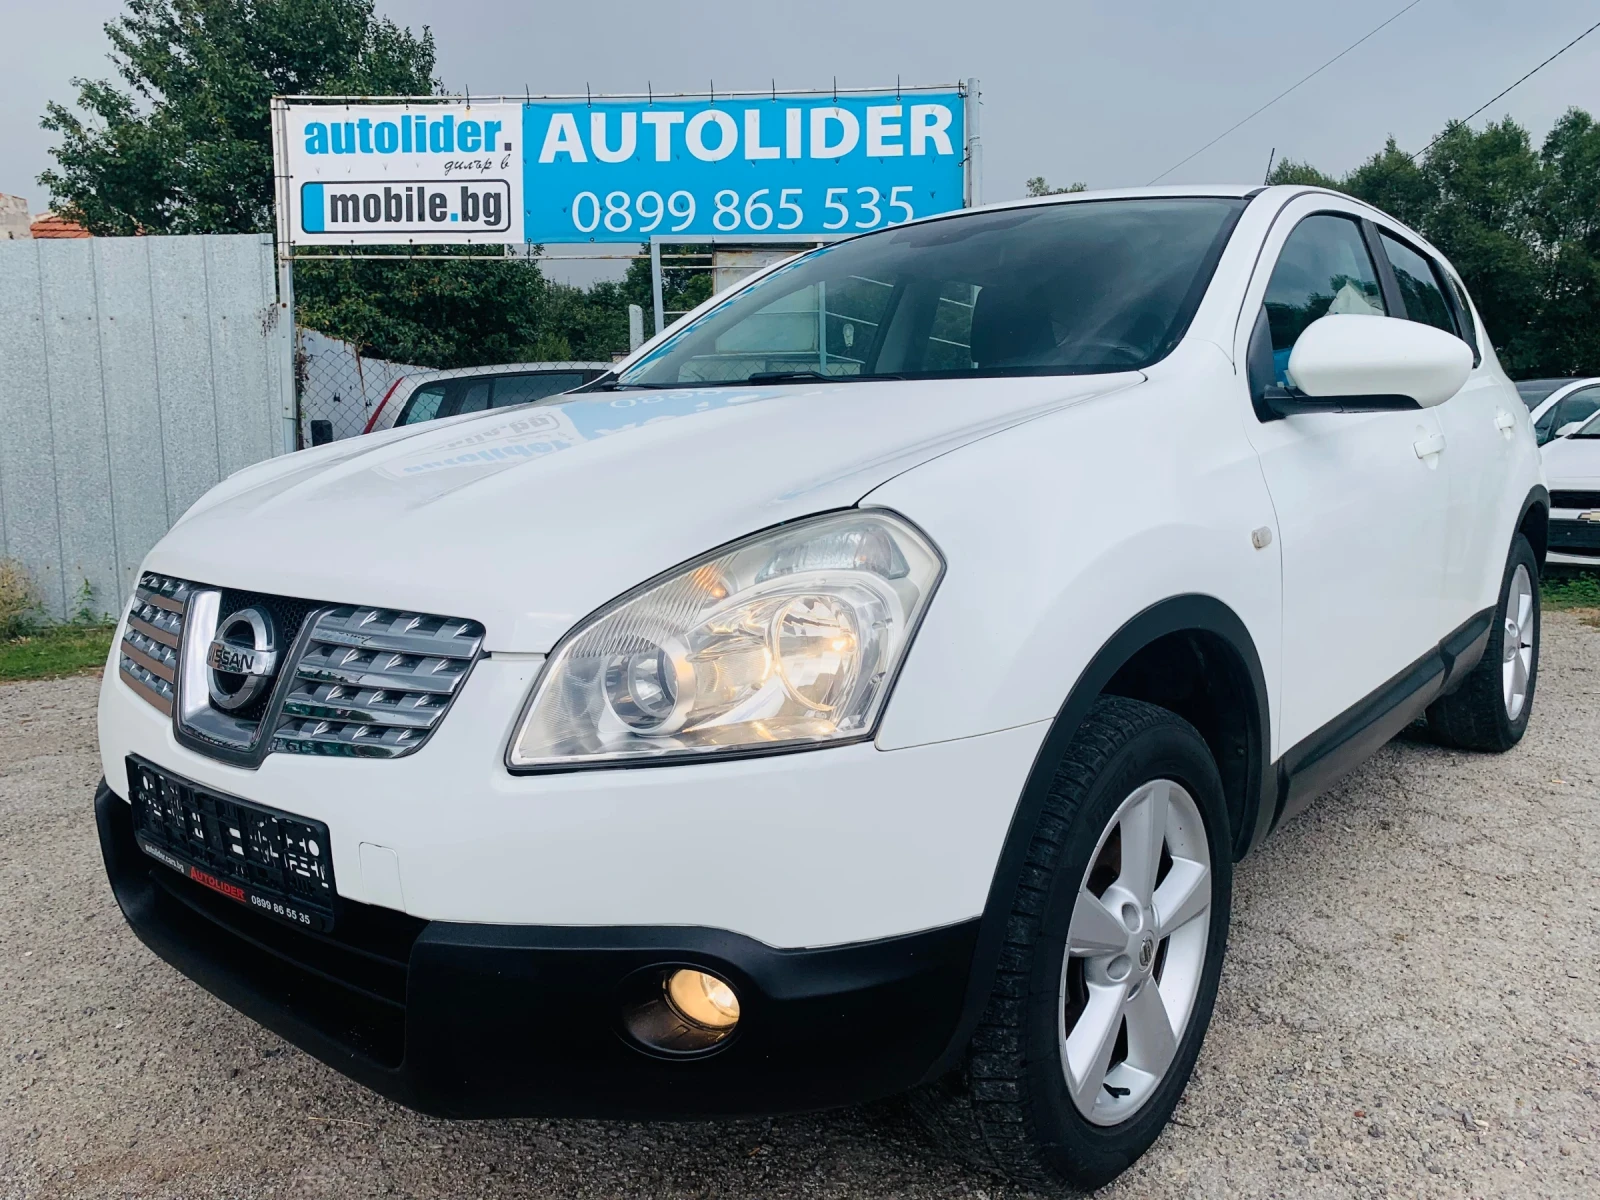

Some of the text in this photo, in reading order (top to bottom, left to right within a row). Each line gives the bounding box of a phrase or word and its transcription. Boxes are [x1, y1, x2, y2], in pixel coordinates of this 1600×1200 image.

[538, 104, 954, 164] AUTOLIDER
[444, 153, 511, 176] дилър в
[330, 186, 502, 226] mobile.bg
[572, 185, 914, 233] 0899 865 535
[190, 866, 245, 899] AUTOLIDER
[251, 895, 272, 910] 0899
[273, 903, 285, 915] 86
[286, 907, 298, 920] 55
[299, 912, 311, 925] 35
